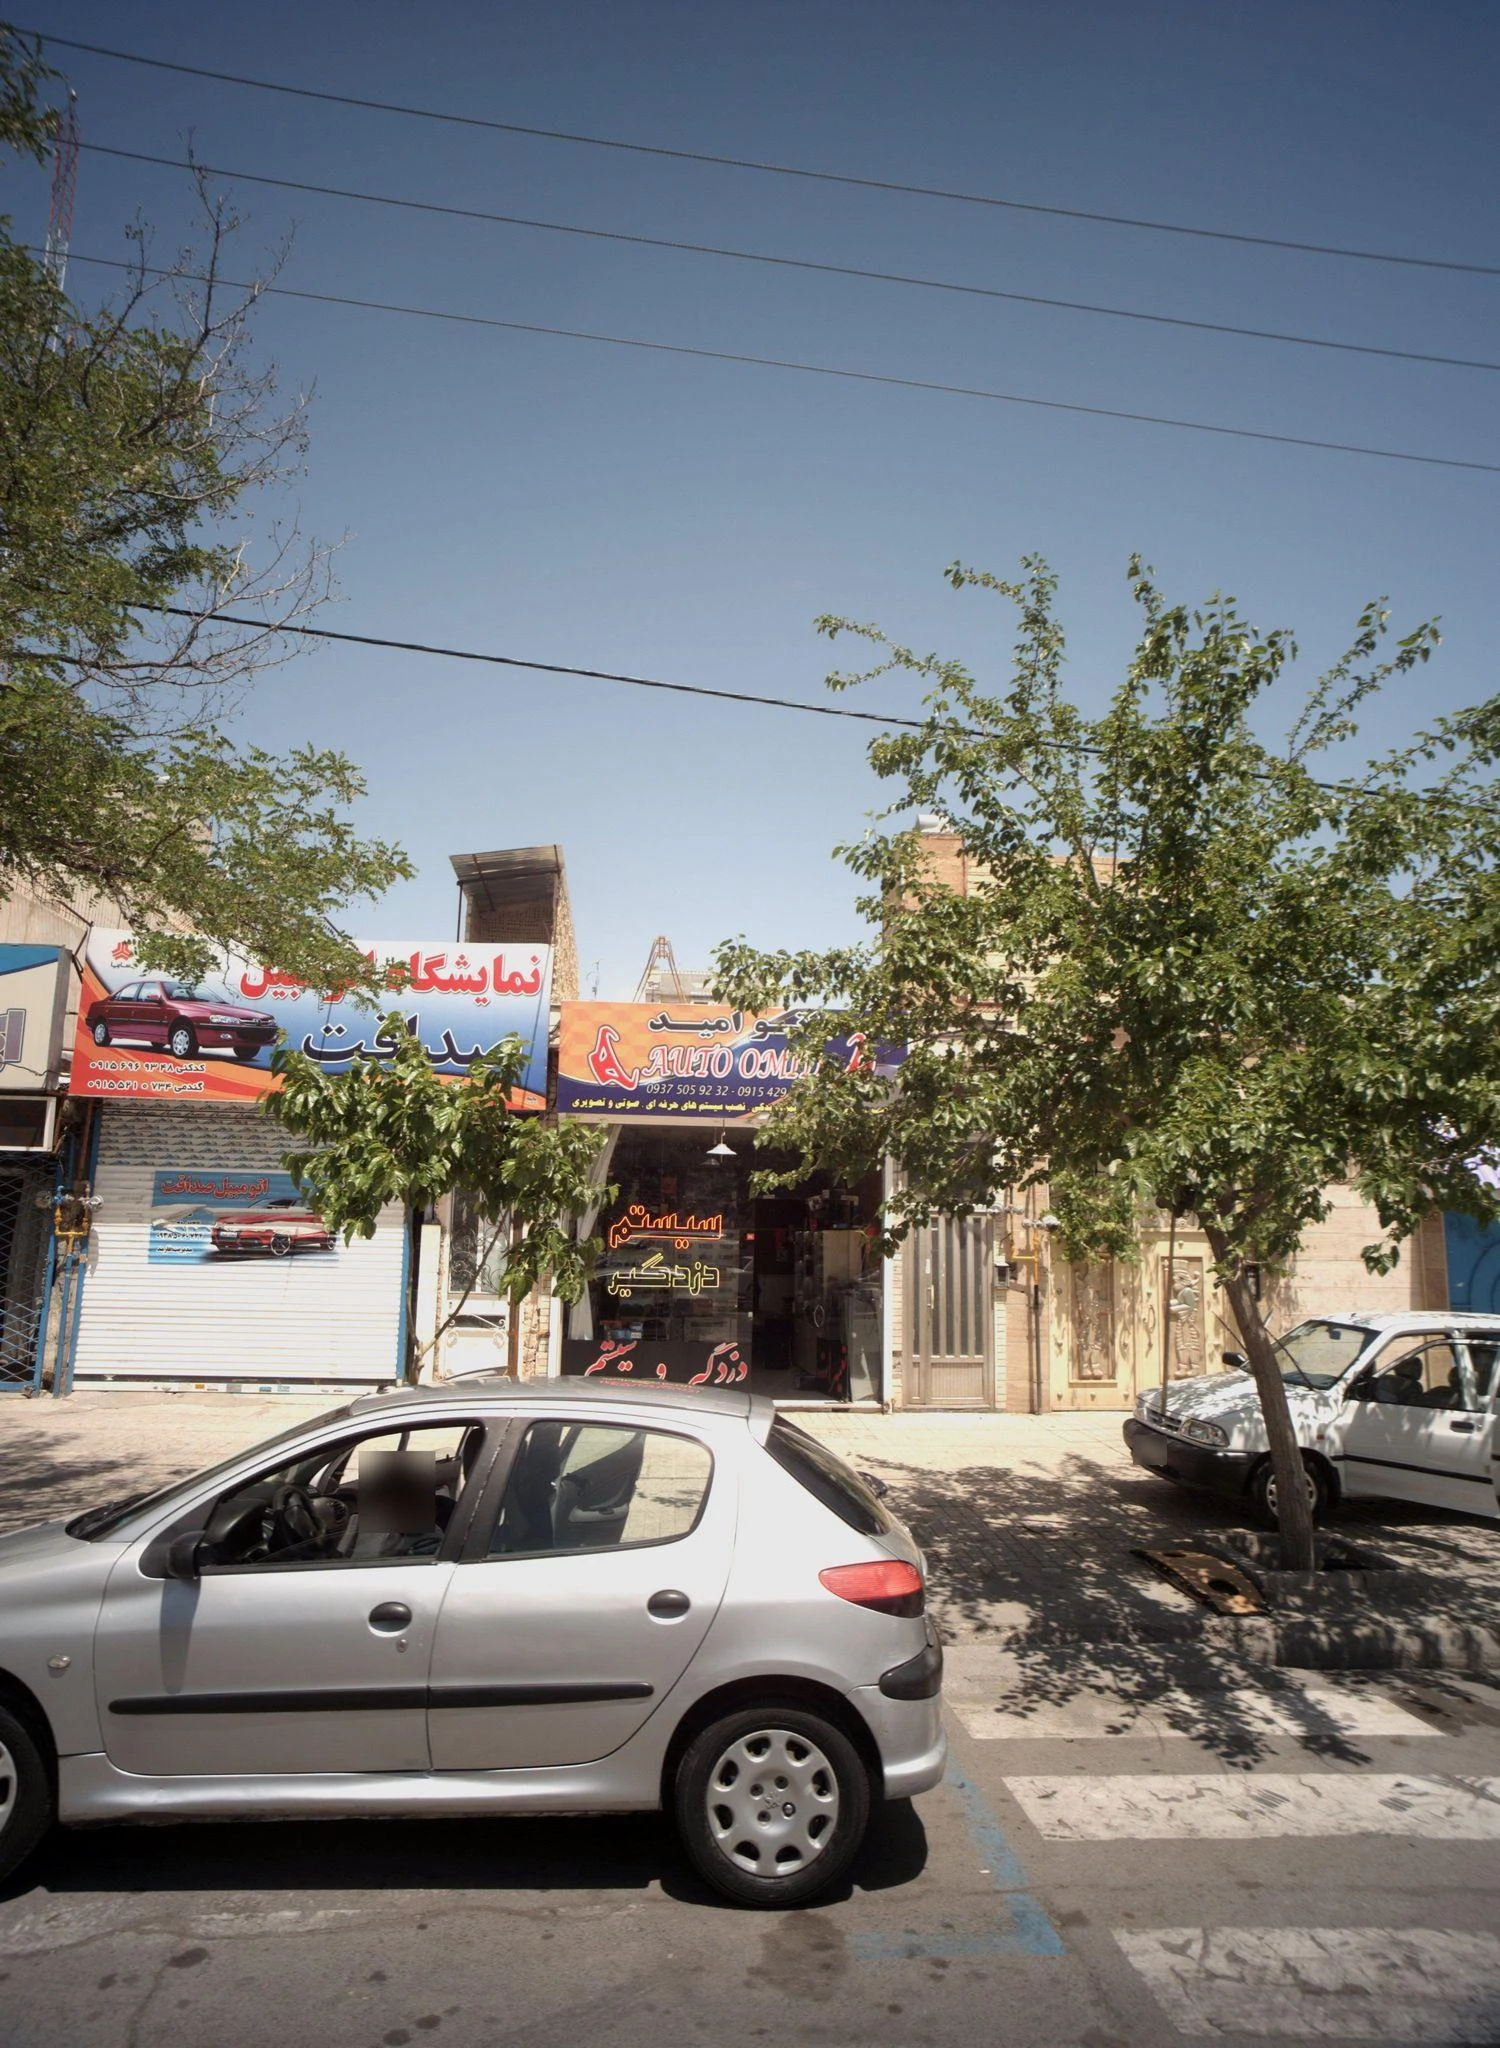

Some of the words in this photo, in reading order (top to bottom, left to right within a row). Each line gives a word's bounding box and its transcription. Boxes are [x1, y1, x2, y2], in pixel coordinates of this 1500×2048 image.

[385, 949, 543, 1006] نمایشگاه
[647, 1009, 745, 1040] امید
[640, 1044, 734, 1079] AUTO
[646, 1083, 674, 1095] 0937
[676, 1084, 696, 1096] 505
[698, 1085, 713, 1096] 92
[715, 1085, 729, 1097] 32
[737, 1086, 764, 1098] 0915
[766, 1087, 788, 1098] 429
[609, 1205, 723, 1249] سیستم
[607, 1252, 720, 1297] دزدگیر
[584, 1340, 638, 1377] سیستم
[655, 1362, 667, 1380] و
